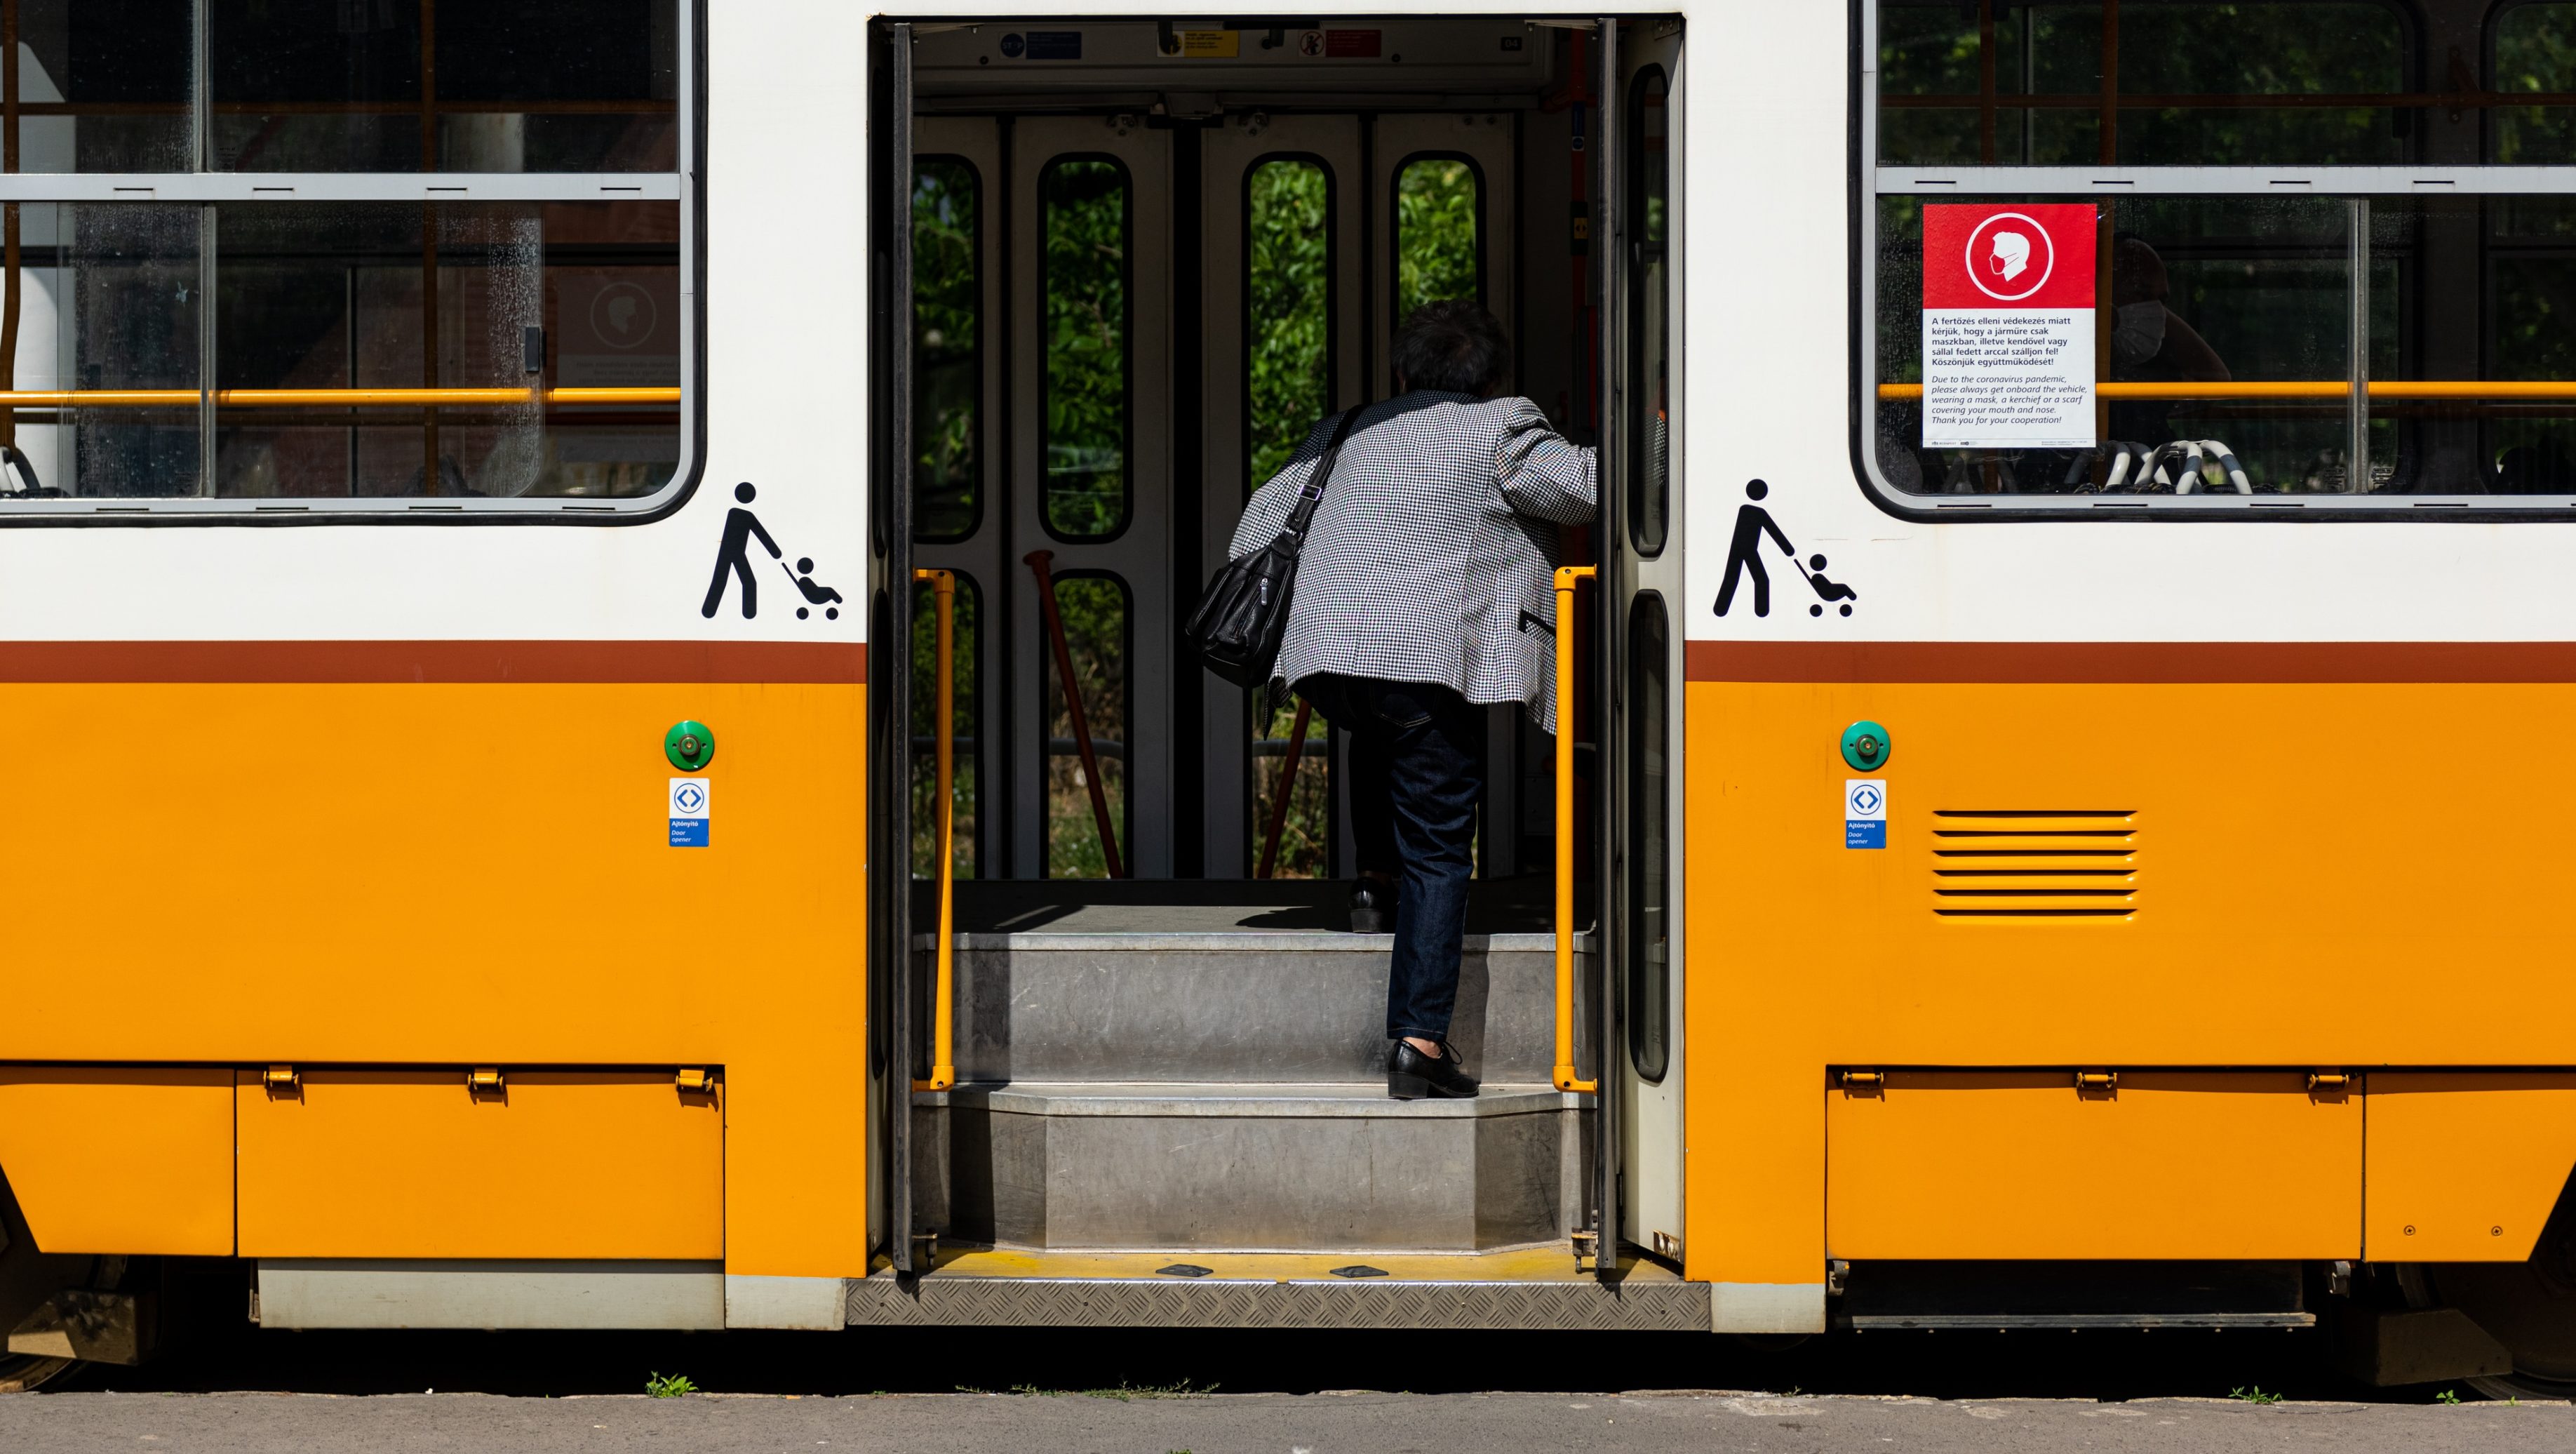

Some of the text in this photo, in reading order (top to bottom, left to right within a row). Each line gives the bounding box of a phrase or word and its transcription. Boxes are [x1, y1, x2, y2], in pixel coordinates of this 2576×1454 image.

[1505, 39, 1518, 48] 04
[1932, 328, 1961, 336] kérjük,
[1964, 328, 1985, 336] hogy
[1994, 328, 2027, 336] járműre
[1932, 338, 1977, 346] maszkban,
[2011, 348, 2042, 356] szálljon
[1932, 358, 2053, 367] Köszönjük együttműködését!
[2025, 375, 2067, 384] pandemic,
[1931, 386, 1958, 394] please
[1960, 386, 1988, 394] always
[2059, 385, 2088, 394] vehicle,
[1932, 396, 1965, 405] wearing
[1975, 396, 1998, 404] mask,
[2009, 396, 2041, 404] kerchief
[2062, 395, 2083, 404] scarf
[1931, 406, 1966, 415] covering
[1975, 416, 1987, 425] for
[2011, 416, 2062, 425] cooperation!
